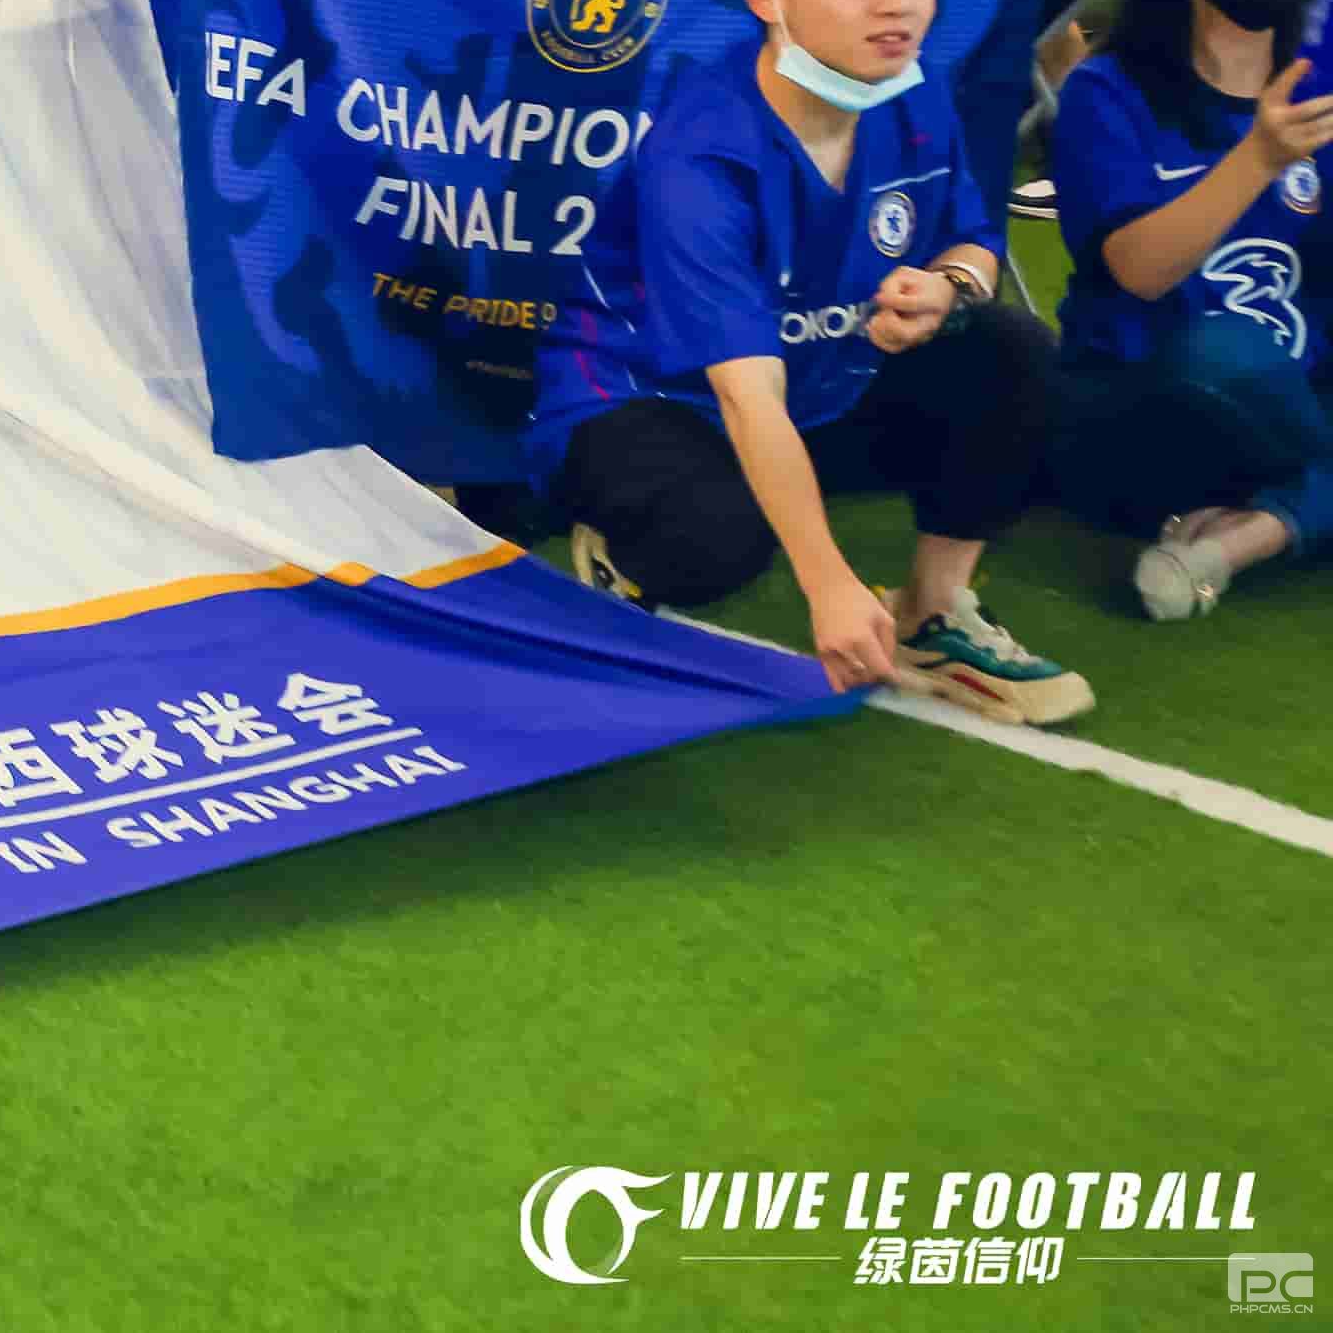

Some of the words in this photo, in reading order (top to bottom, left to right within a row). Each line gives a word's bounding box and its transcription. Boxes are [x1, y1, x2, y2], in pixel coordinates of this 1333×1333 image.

[205, 31, 308, 117] EFA
[355, 175, 533, 254] FINAL
[372, 272, 438, 311] THE
[443, 294, 537, 331] PRIDE
[108, 741, 468, 853] SHANGHAI
